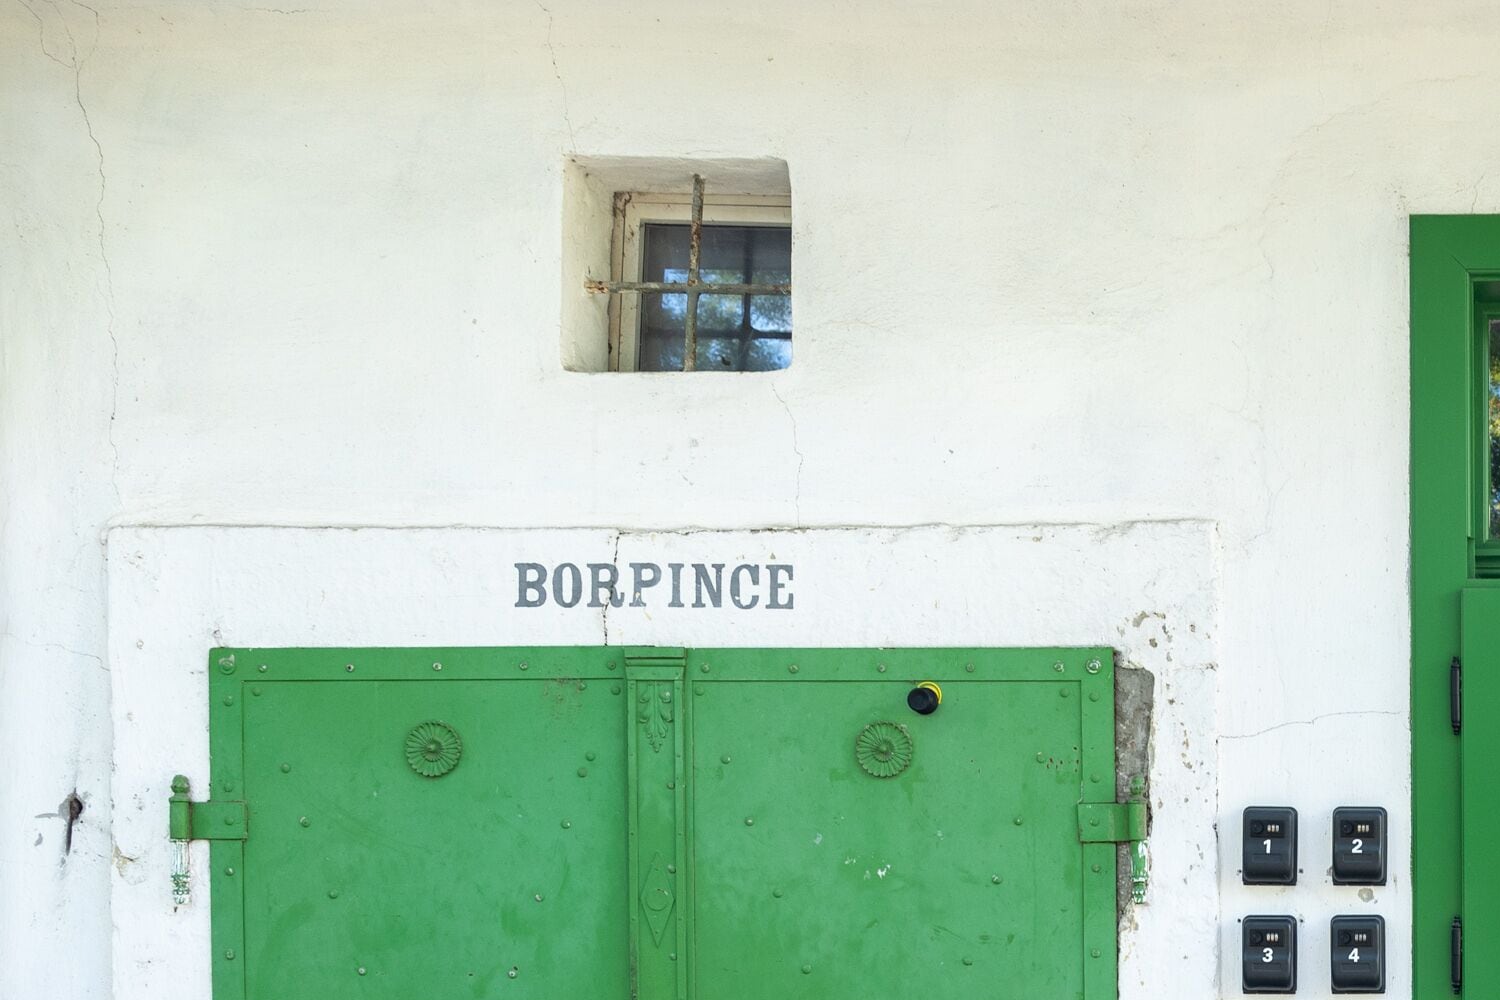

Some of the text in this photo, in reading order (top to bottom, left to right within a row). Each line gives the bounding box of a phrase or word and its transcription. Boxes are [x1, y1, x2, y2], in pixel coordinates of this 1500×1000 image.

[514, 562, 794, 610] BORPINCE
[1263, 839, 1272, 854] 1
[1351, 838, 1363, 854] 2
[1262, 947, 1274, 963] 3
[1348, 947, 1360, 963] 4
